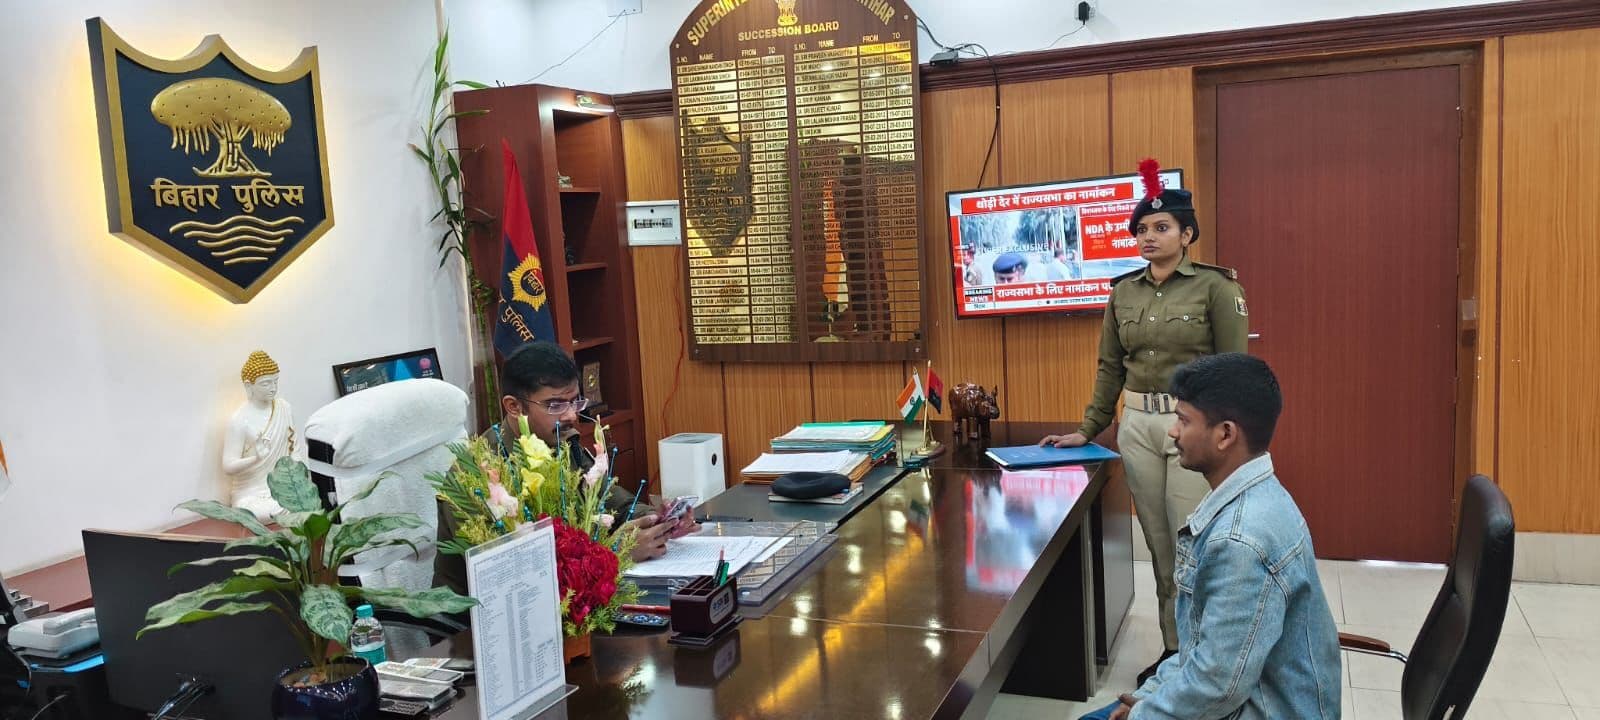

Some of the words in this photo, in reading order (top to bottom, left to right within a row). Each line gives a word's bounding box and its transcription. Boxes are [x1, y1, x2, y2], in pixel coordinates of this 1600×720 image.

[738, 25, 802, 41] SUCCESSION
[804, 21, 840, 34] BOARD
[818, 40, 835, 48] NAME
[862, 34, 879, 43] FROM
[892, 32, 901, 40] TO
[768, 46, 776, 54] TO
[150, 177, 221, 213] बिहार
[231, 177, 305, 214] पुलिस
[976, 195, 997, 211] थोड़ी
[998, 194, 1011, 208] देर
[1012, 193, 1021, 206] में
[1022, 191, 1062, 206] राज्यसभा
[1064, 190, 1078, 201] का
[1078, 186, 1117, 199] नामांकन
[1085, 223, 1105, 235] NDA
[1105, 220, 1114, 232] के
[1113, 219, 1131, 233] उम्मी
[1005, 243, 1049, 254] EXCLUSIVE
[1112, 236, 1137, 249] नामांक
[996, 287, 1033, 300] राज्यसभा
[1035, 284, 1044, 296] के
[1046, 282, 1064, 295] लिए
[1065, 280, 1100, 293] नामांकन
[501, 304, 536, 343] पुलिस
